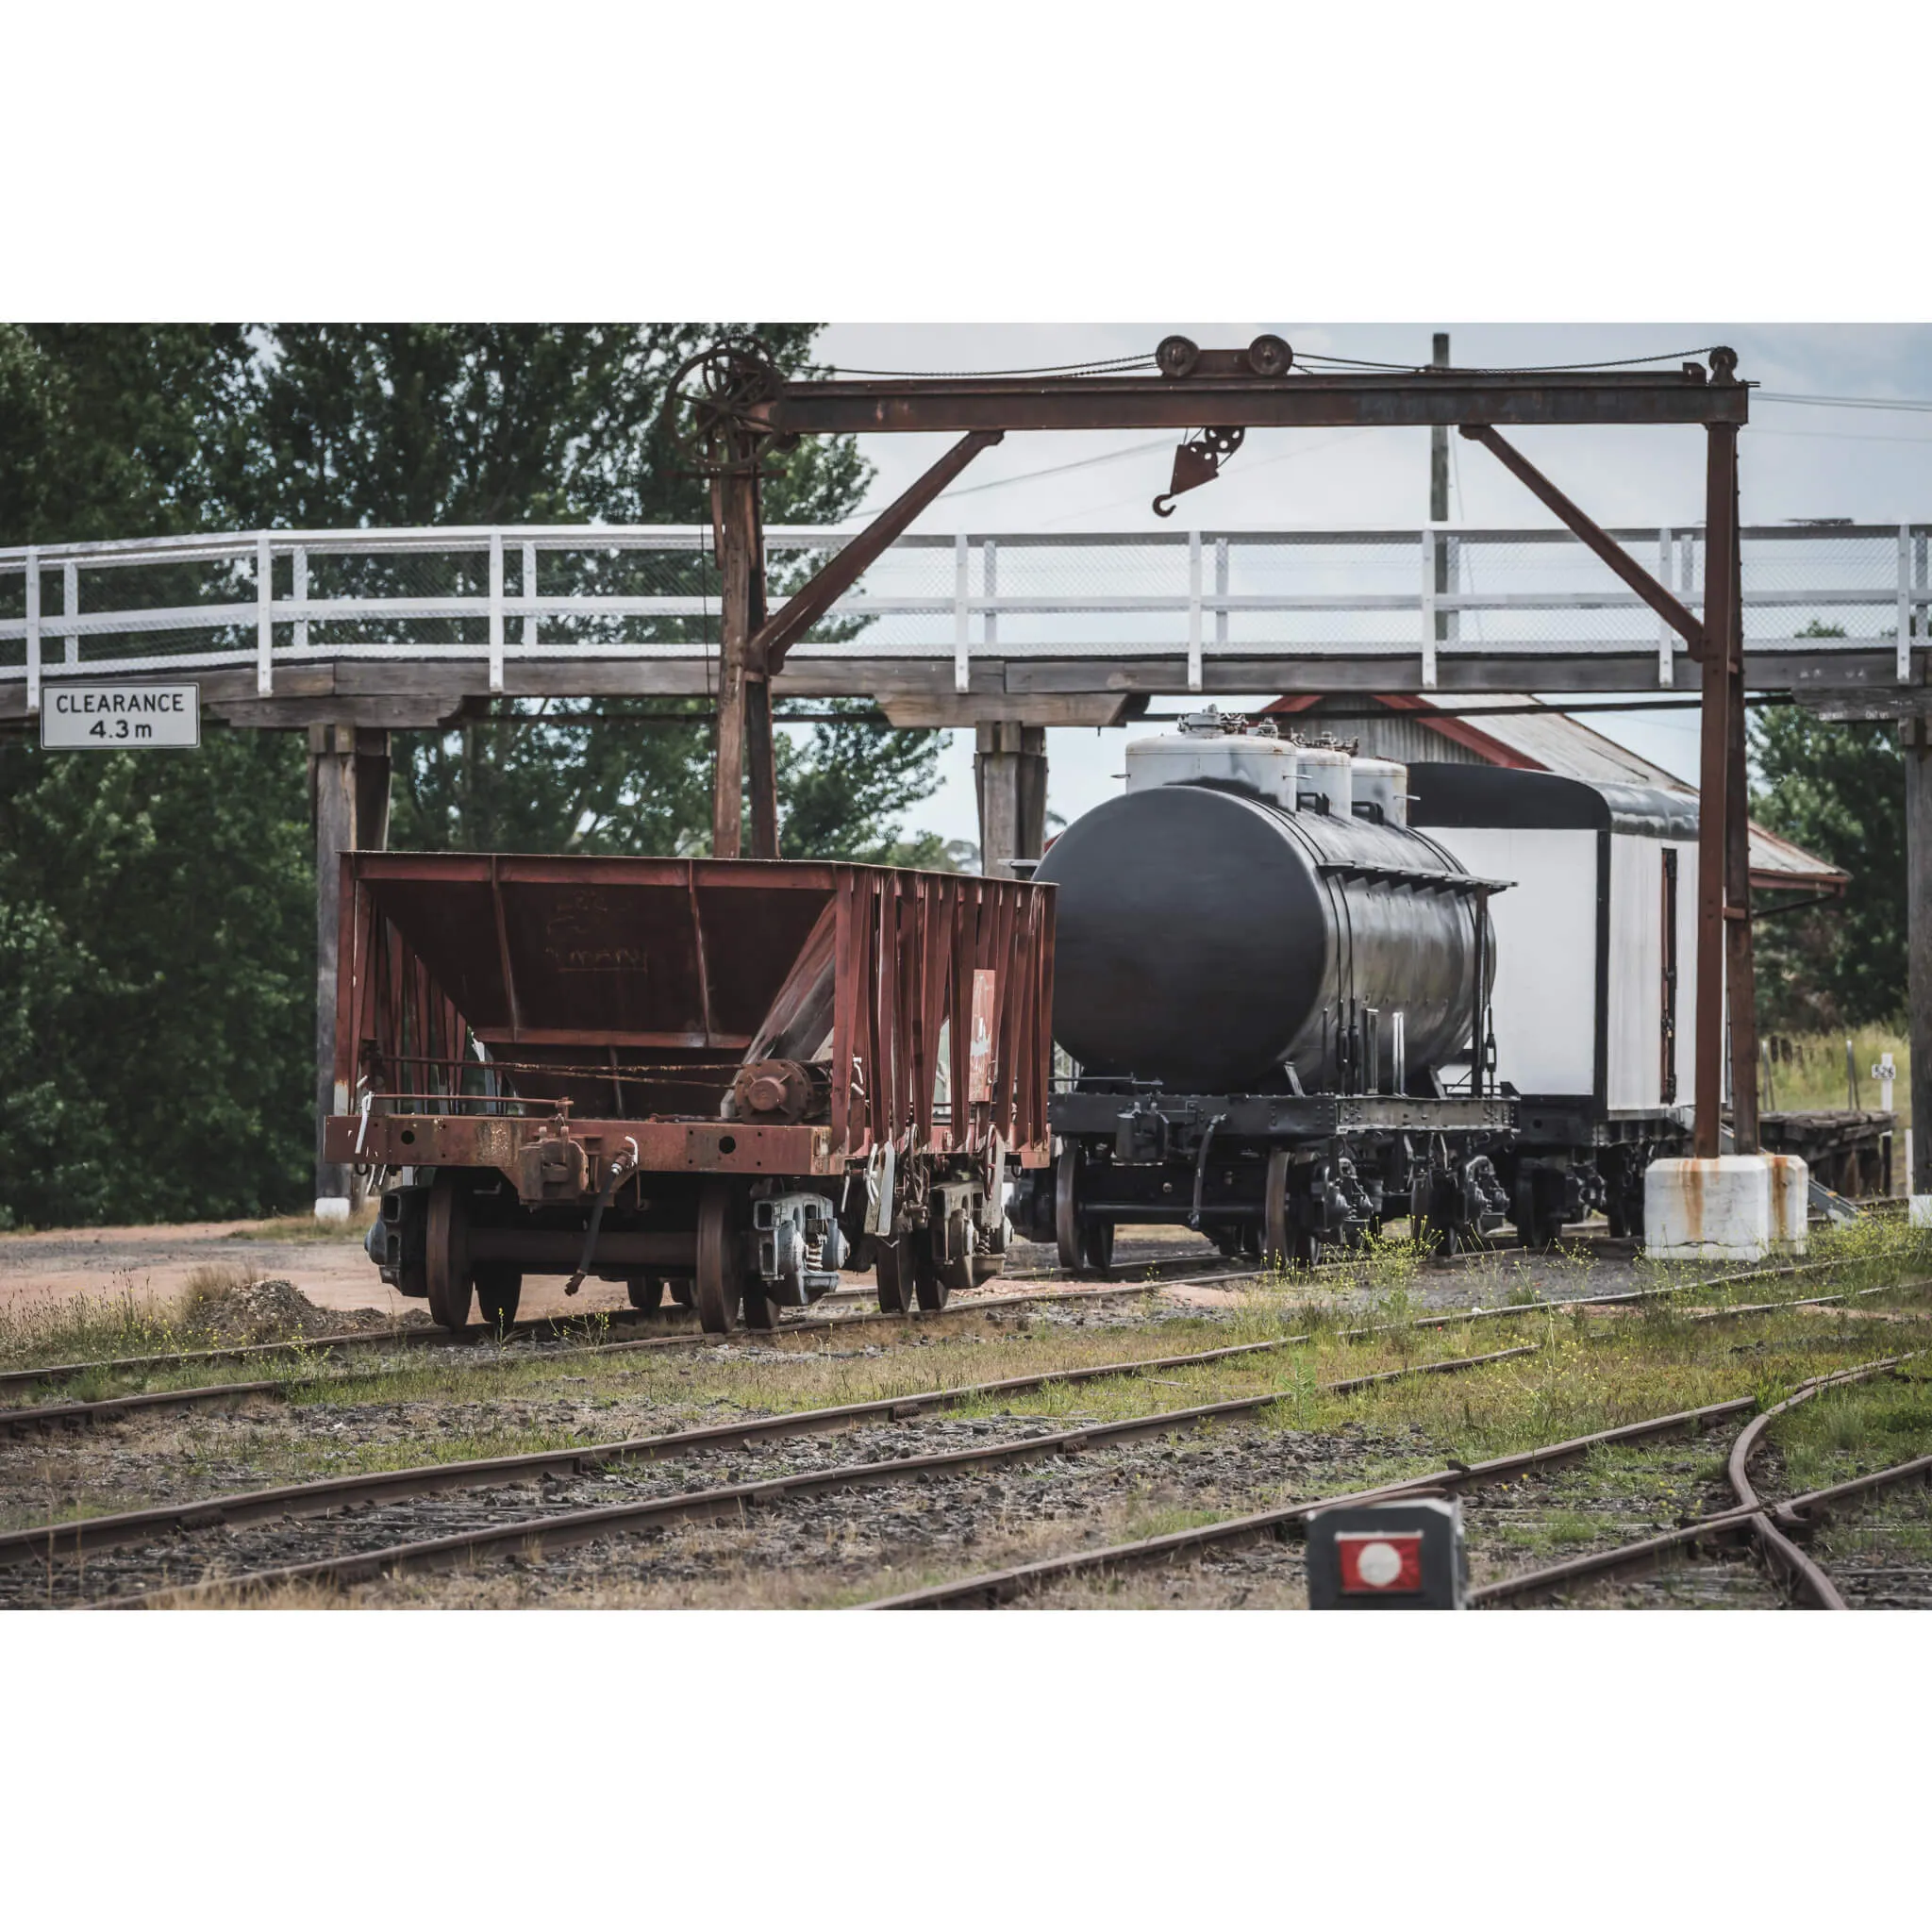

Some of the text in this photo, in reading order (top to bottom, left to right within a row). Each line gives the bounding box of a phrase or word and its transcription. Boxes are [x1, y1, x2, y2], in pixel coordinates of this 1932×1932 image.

[56, 693, 185, 714] CLEARANCE
[89, 719, 153, 740] 4.3 m
